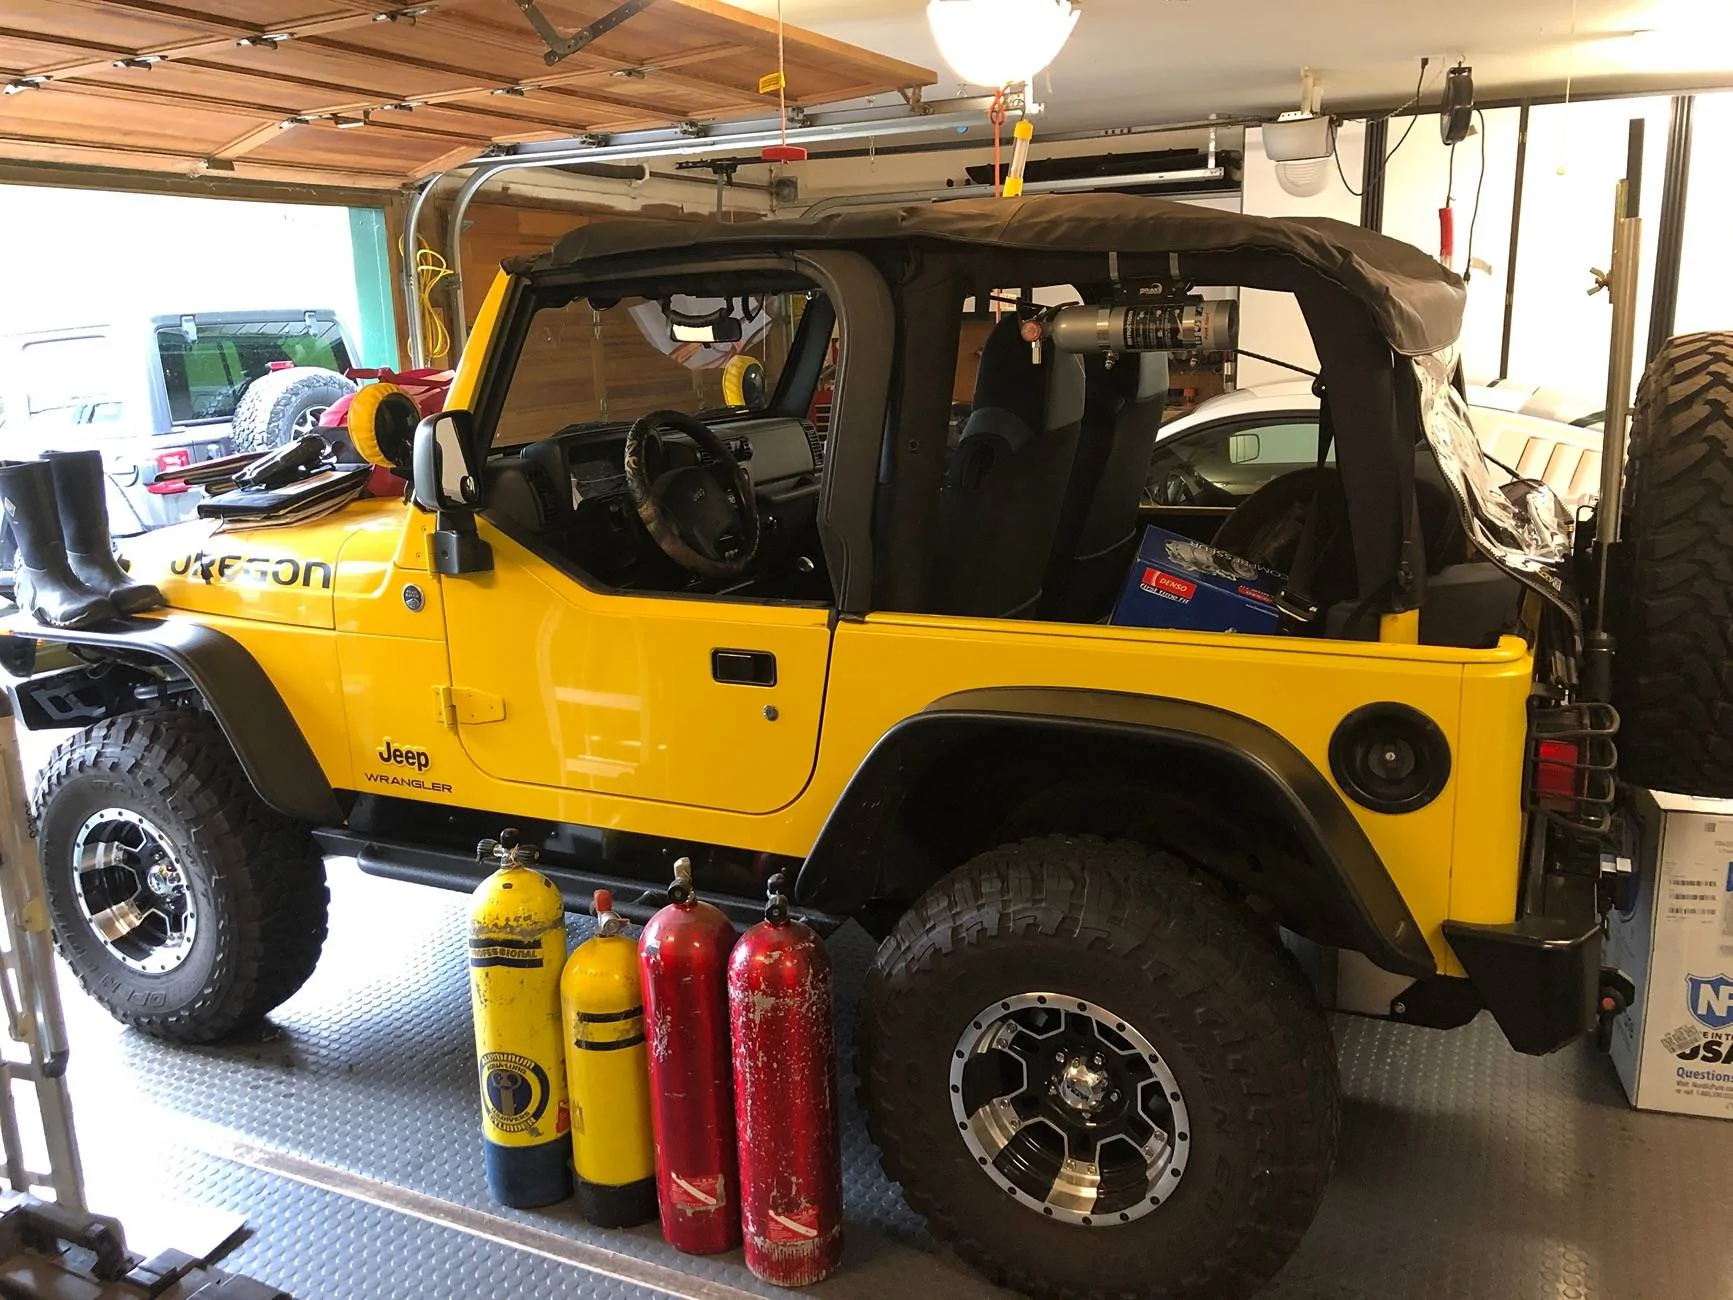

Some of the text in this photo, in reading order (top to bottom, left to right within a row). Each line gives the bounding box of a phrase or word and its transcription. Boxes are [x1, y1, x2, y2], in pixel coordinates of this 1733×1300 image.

[1159, 577, 1188, 592] DENSO
[378, 741, 430, 772] Jeep
[365, 772, 453, 793] WRANGLER
[1711, 1032, 1721, 1041] IN
